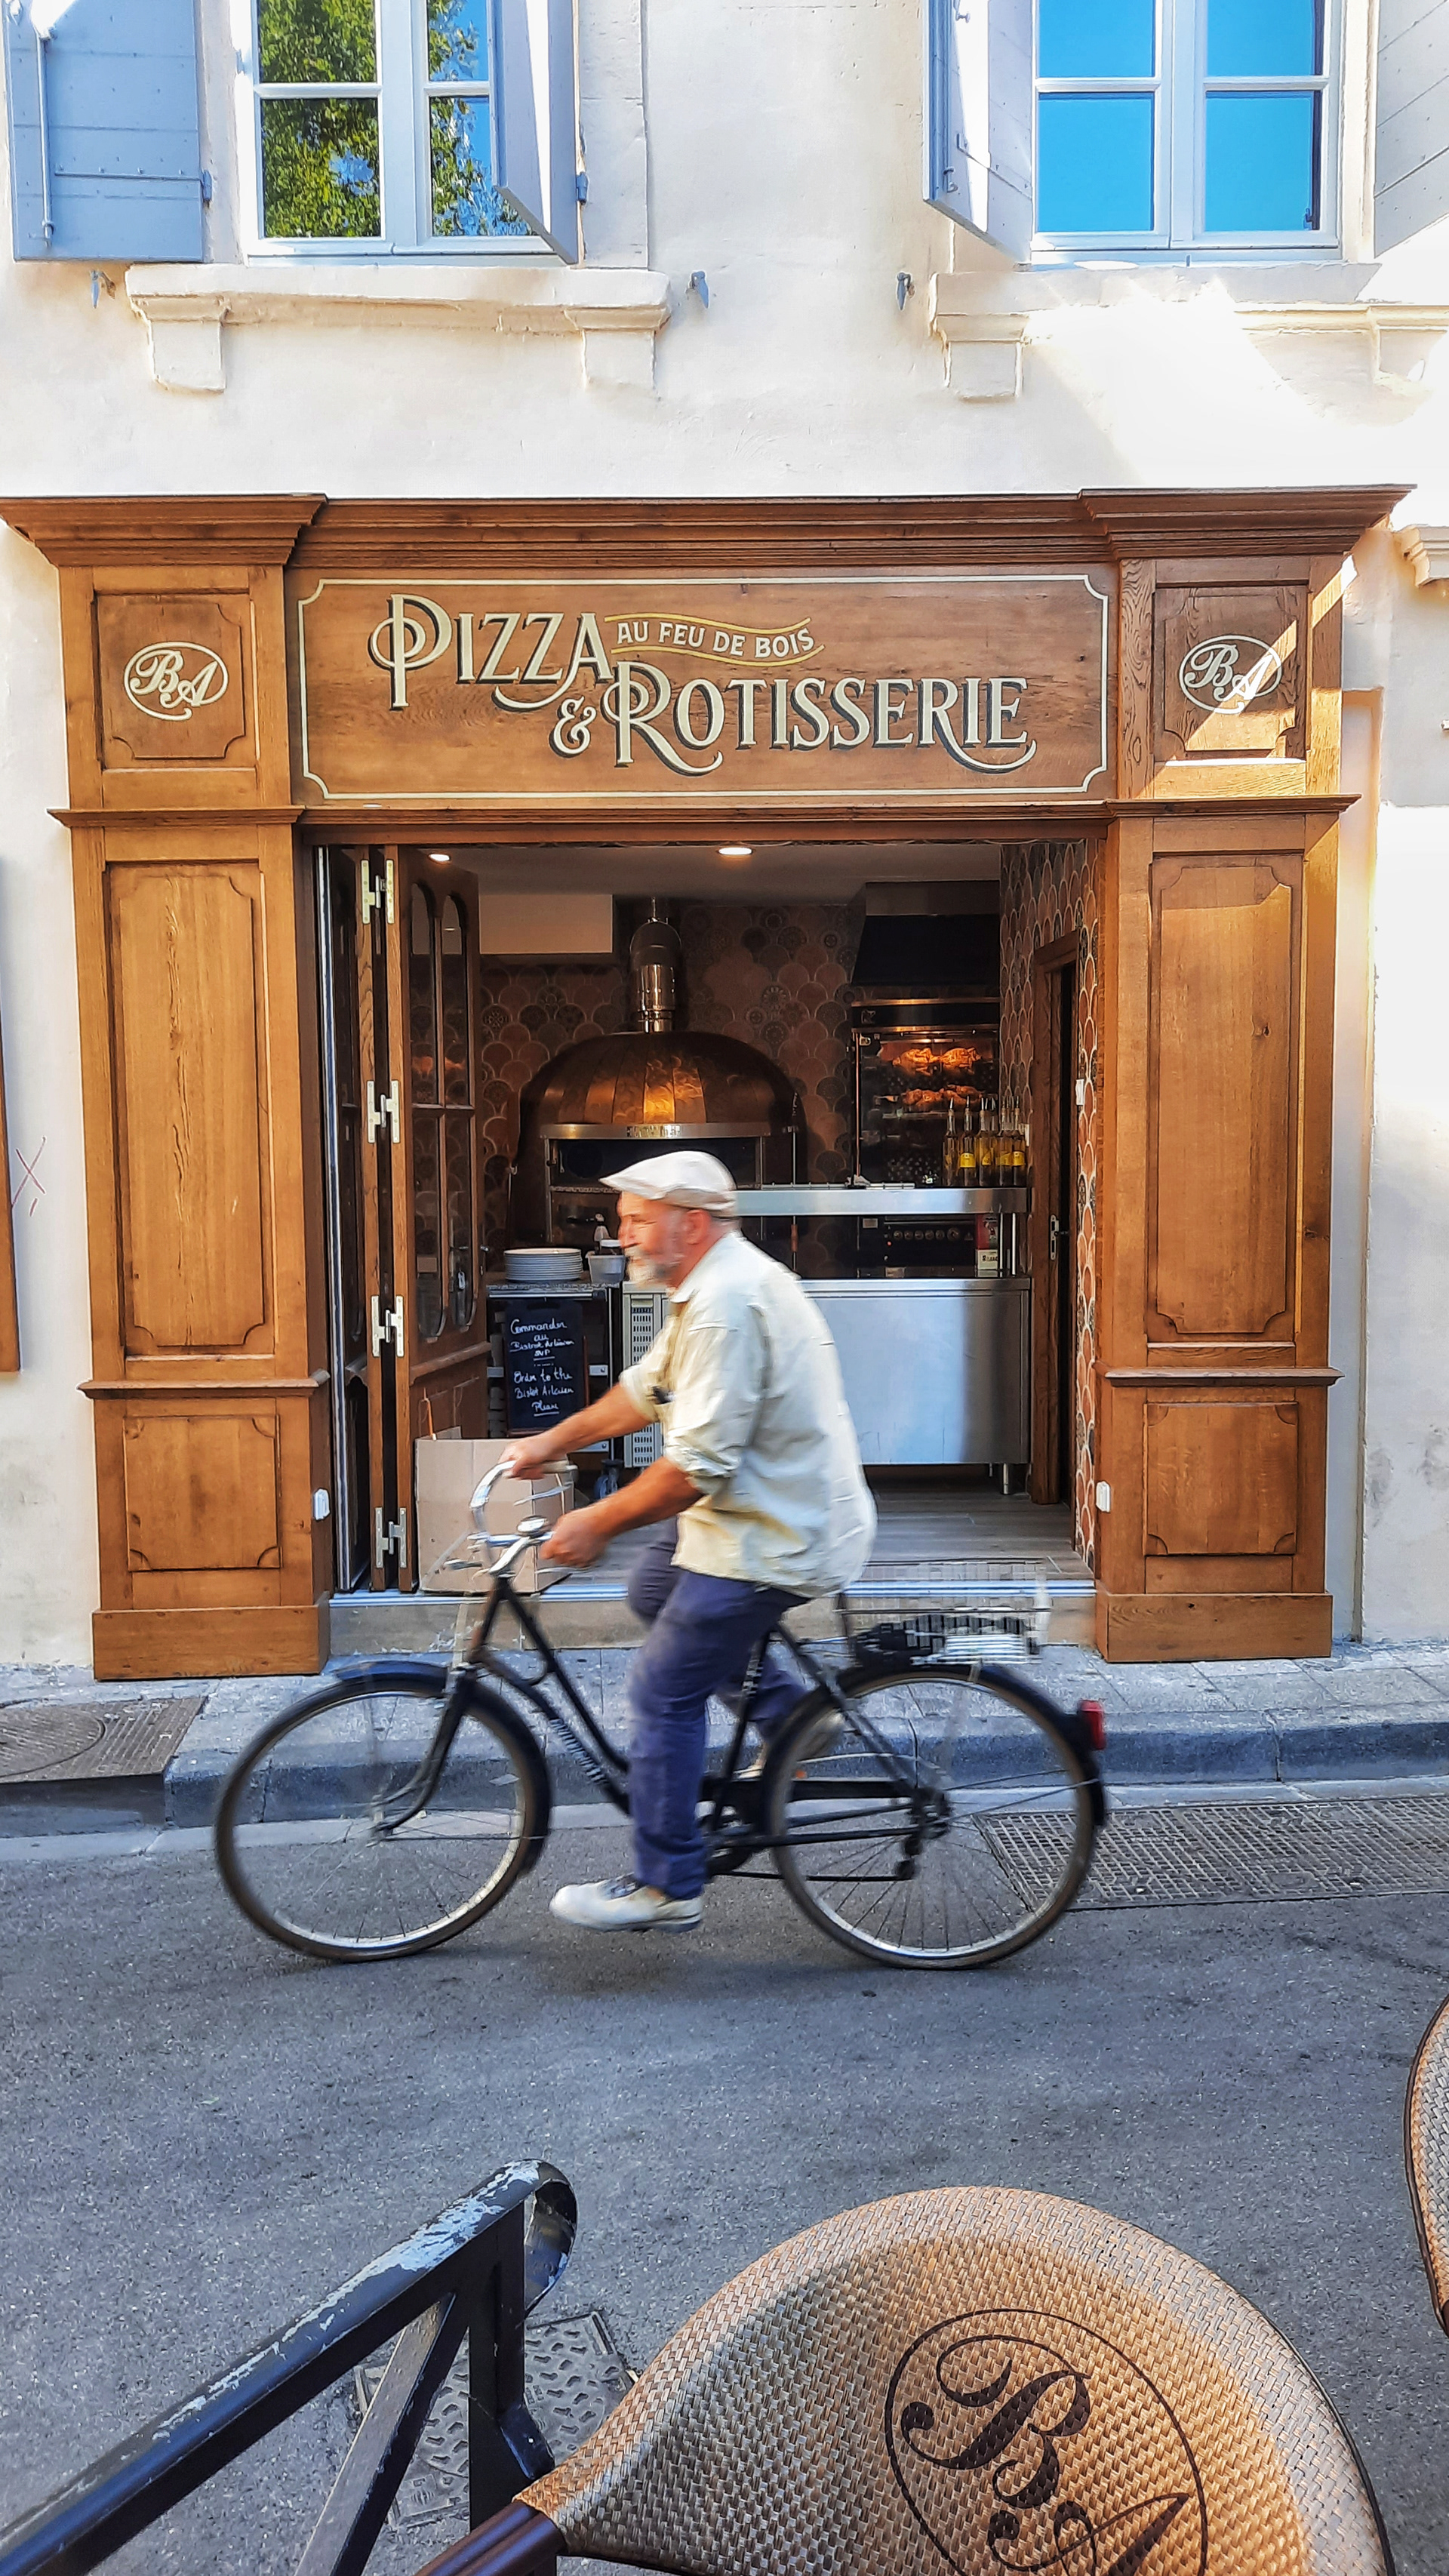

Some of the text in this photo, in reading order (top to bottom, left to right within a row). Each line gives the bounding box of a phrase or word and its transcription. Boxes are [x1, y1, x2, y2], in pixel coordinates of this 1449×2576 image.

[368, 593, 614, 712] PIZZA
[617, 621, 815, 658] AU FEU DE BOIS
[549, 660, 1038, 777] & ROTISSERIE
[534, 1349, 551, 1357] SVP
[540, 1368, 551, 1382] to
[553, 1366, 573, 1380] the
